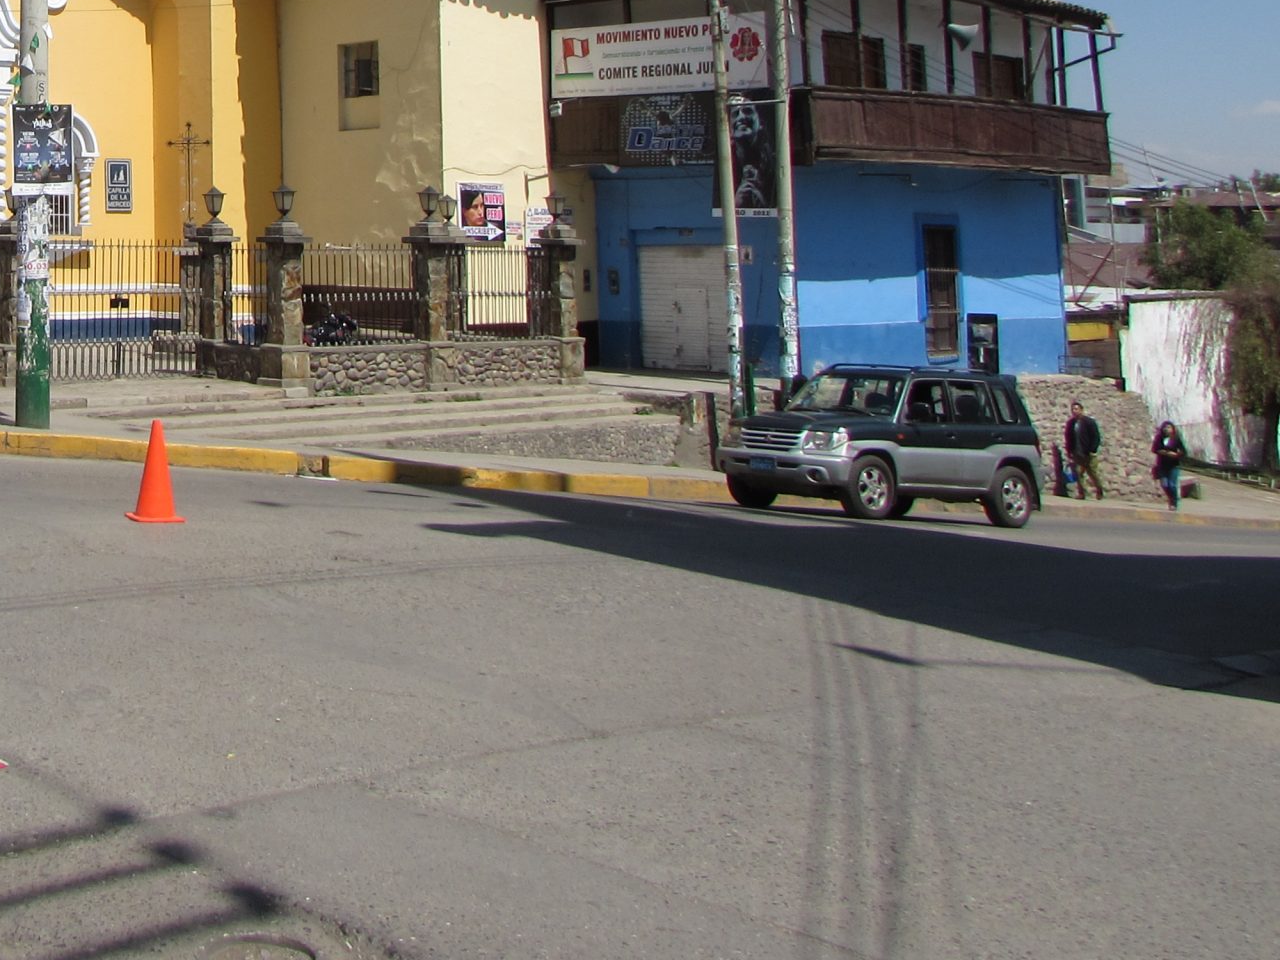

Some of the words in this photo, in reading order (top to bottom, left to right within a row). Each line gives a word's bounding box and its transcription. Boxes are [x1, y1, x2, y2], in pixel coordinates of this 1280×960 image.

[596, 27, 661, 45] MOVIMIENTO
[663, 23, 698, 39] NUEVO
[598, 65, 638, 80] COMITE
[640, 62, 693, 78] REGIONAL
[485, 193, 503, 205] NUEVO
